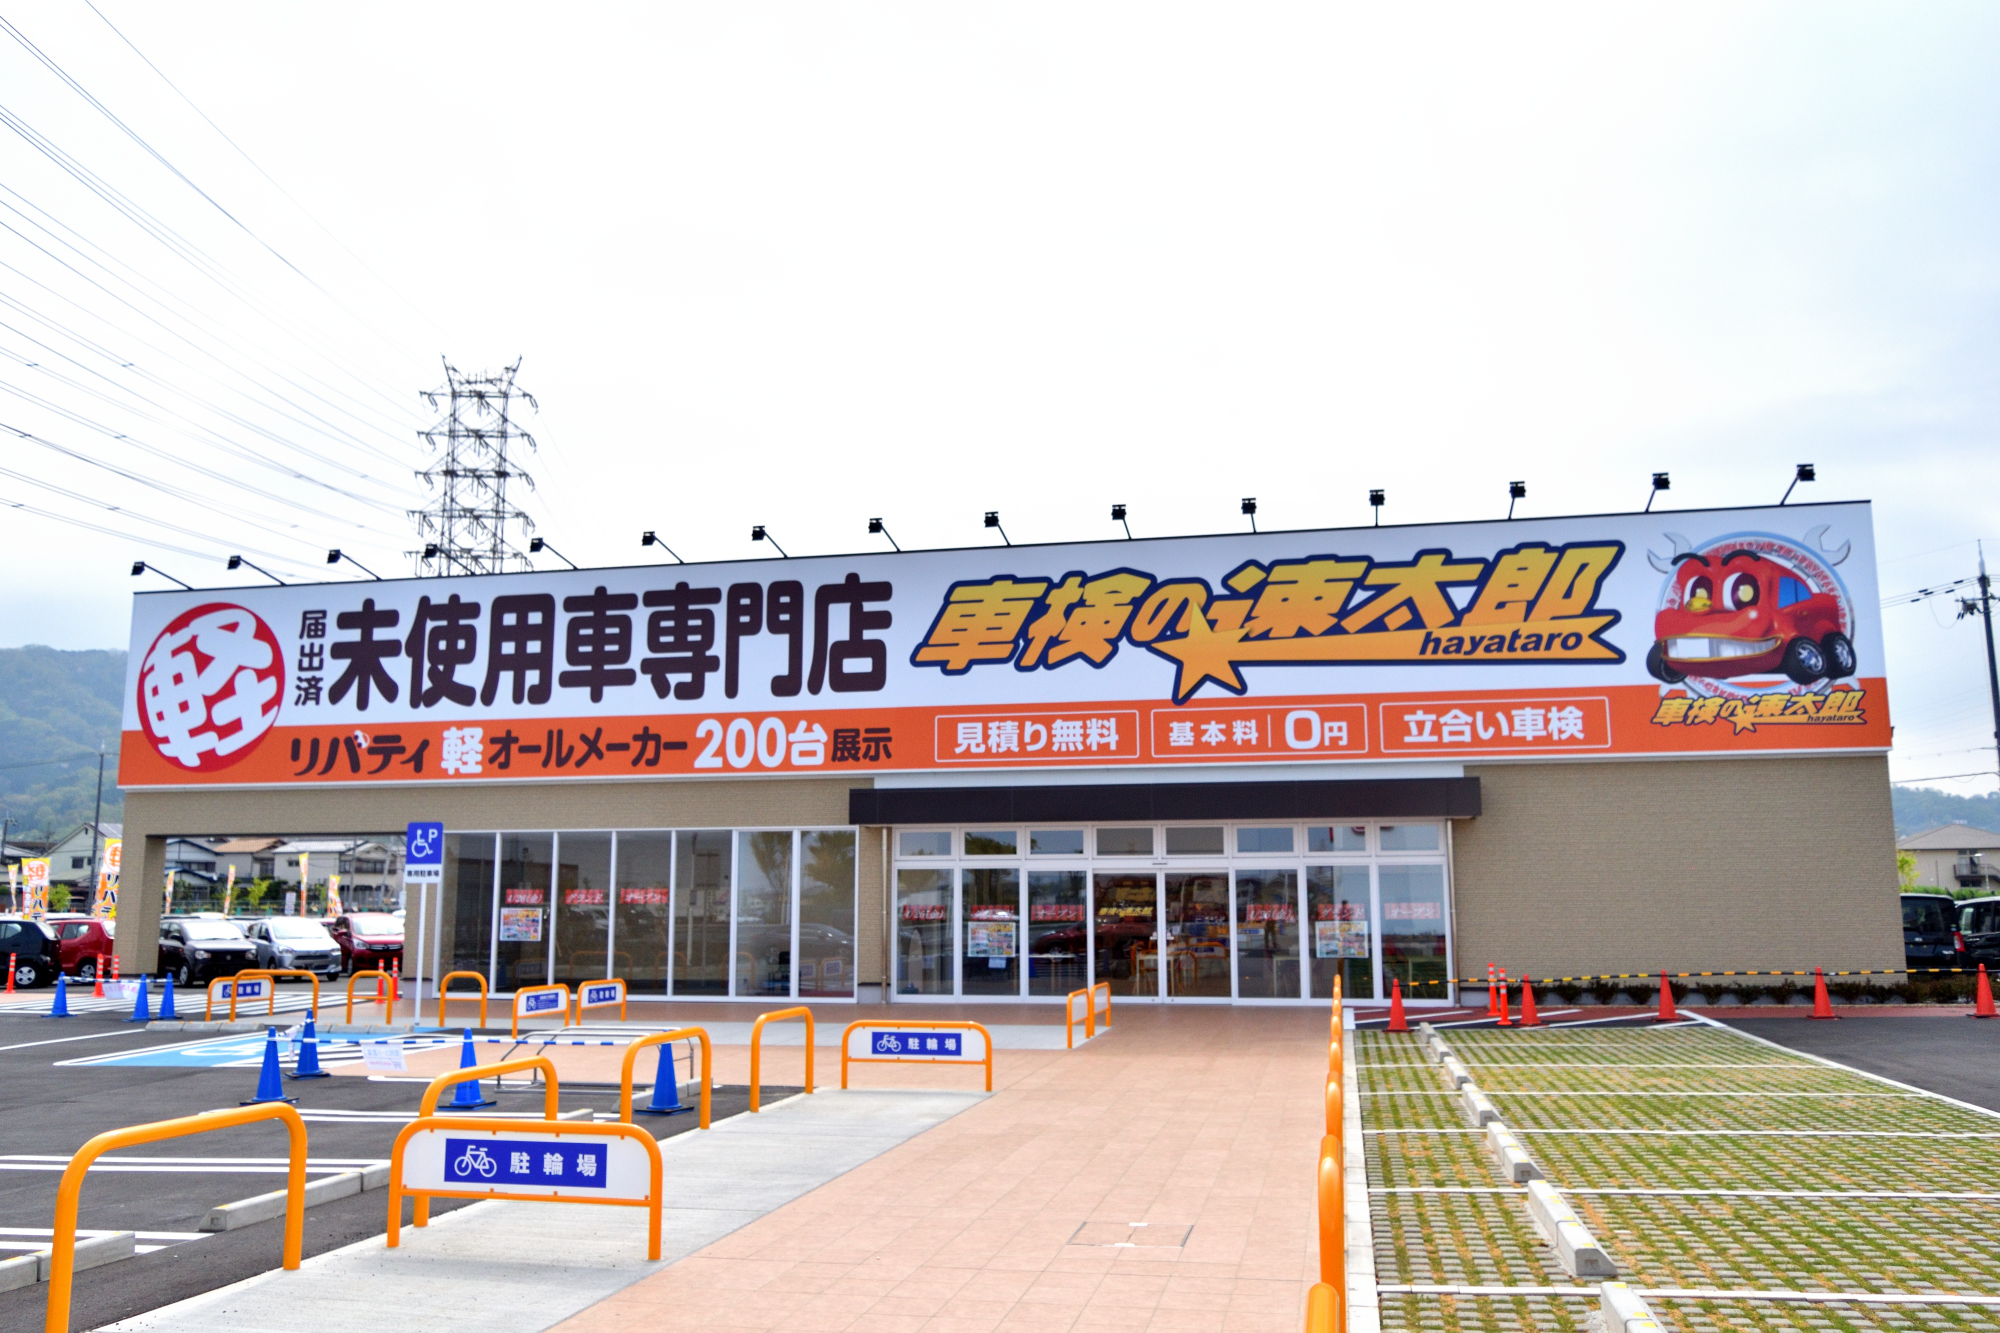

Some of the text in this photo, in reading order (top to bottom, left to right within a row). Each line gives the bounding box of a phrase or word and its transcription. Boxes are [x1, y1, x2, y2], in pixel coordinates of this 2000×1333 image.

[294, 609, 328, 706] 届出済
[328, 572, 893, 711] 未使用車専門店
[1418, 628, 1584, 656] hayataro
[143, 607, 279, 768] 軽
[953, 717, 1120, 754] 見積り無料
[1168, 709, 1349, 750] 基本料 0円
[1403, 705, 1585, 744] 立合い車検
[1806, 713, 1855, 724] hayataro
[428, 828, 439, 843] P
[906, 1036, 958, 1052] 駐輪場
[509, 1151, 598, 1178] 駐輪場
